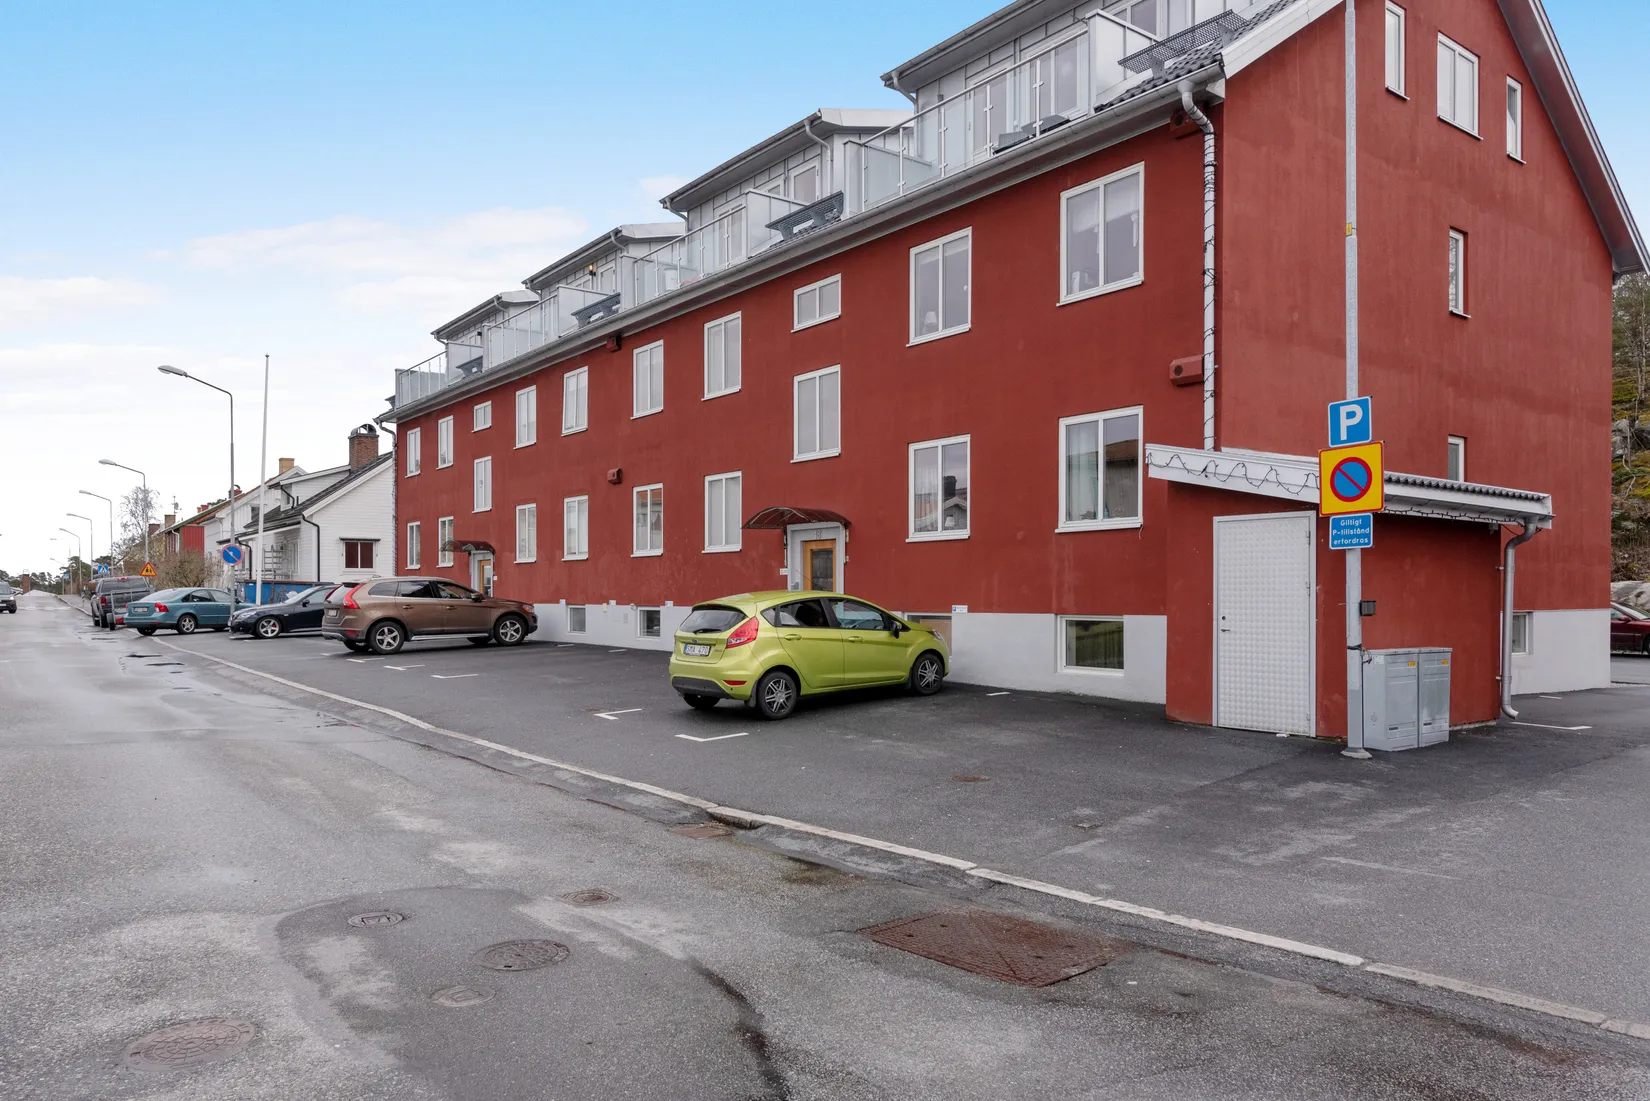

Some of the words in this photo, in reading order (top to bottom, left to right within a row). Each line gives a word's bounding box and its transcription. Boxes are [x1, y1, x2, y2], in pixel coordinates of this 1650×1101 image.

[1339, 403, 1363, 441] P
[1340, 518, 1362, 527] Giltigt
[1332, 526, 1370, 536] P-tillstånd
[1333, 537, 1369, 545] erfordras
